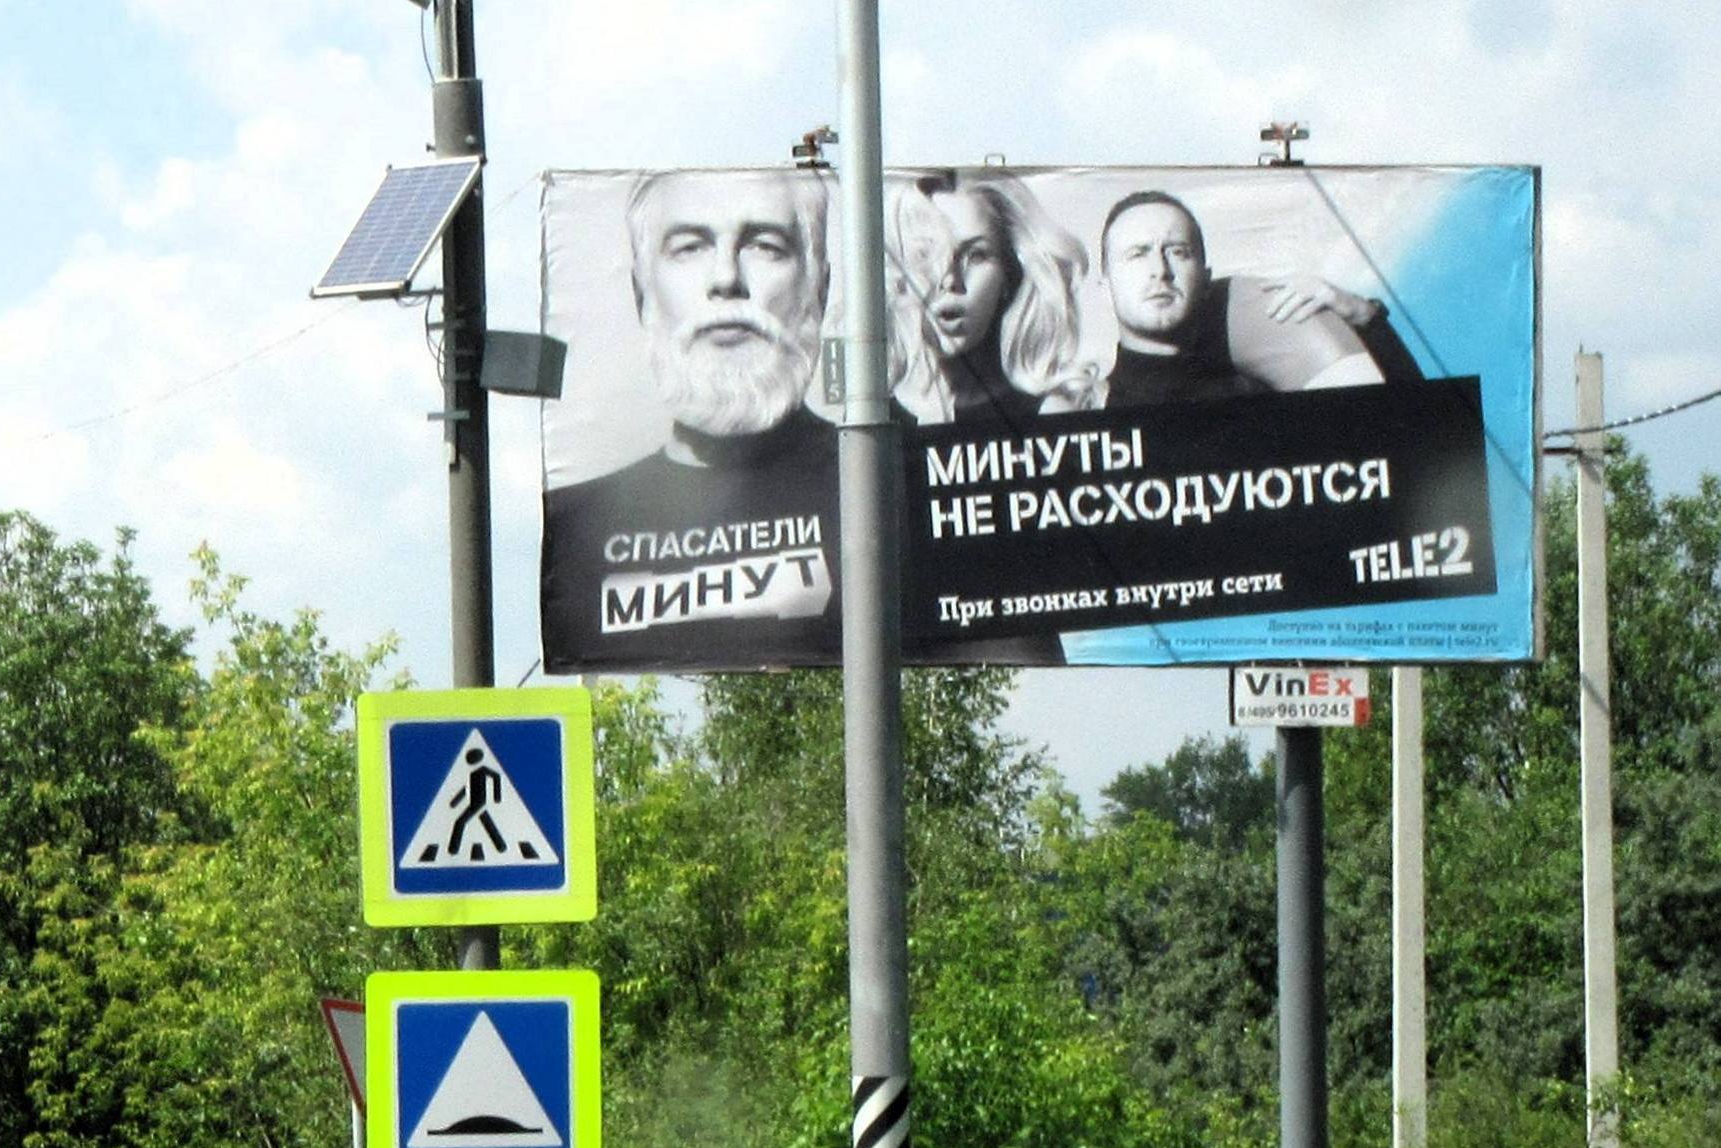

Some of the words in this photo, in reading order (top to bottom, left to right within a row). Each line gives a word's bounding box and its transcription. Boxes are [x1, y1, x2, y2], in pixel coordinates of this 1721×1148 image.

[926, 428, 1144, 487] МИНУТЫ
[930, 495, 996, 539] НЕ
[1008, 458, 1392, 532] РАСХОДУЮТСЯ
[603, 515, 822, 563] СПАСАТЕЛИ
[1348, 526, 1474, 584] TELE2
[606, 555, 819, 626] МИНУТ
[938, 594, 995, 627] При
[1001, 588, 1108, 616] звонках
[1115, 577, 1215, 608] внутри
[1221, 572, 1284, 596] сети
[1245, 671, 1352, 696] VinEx
